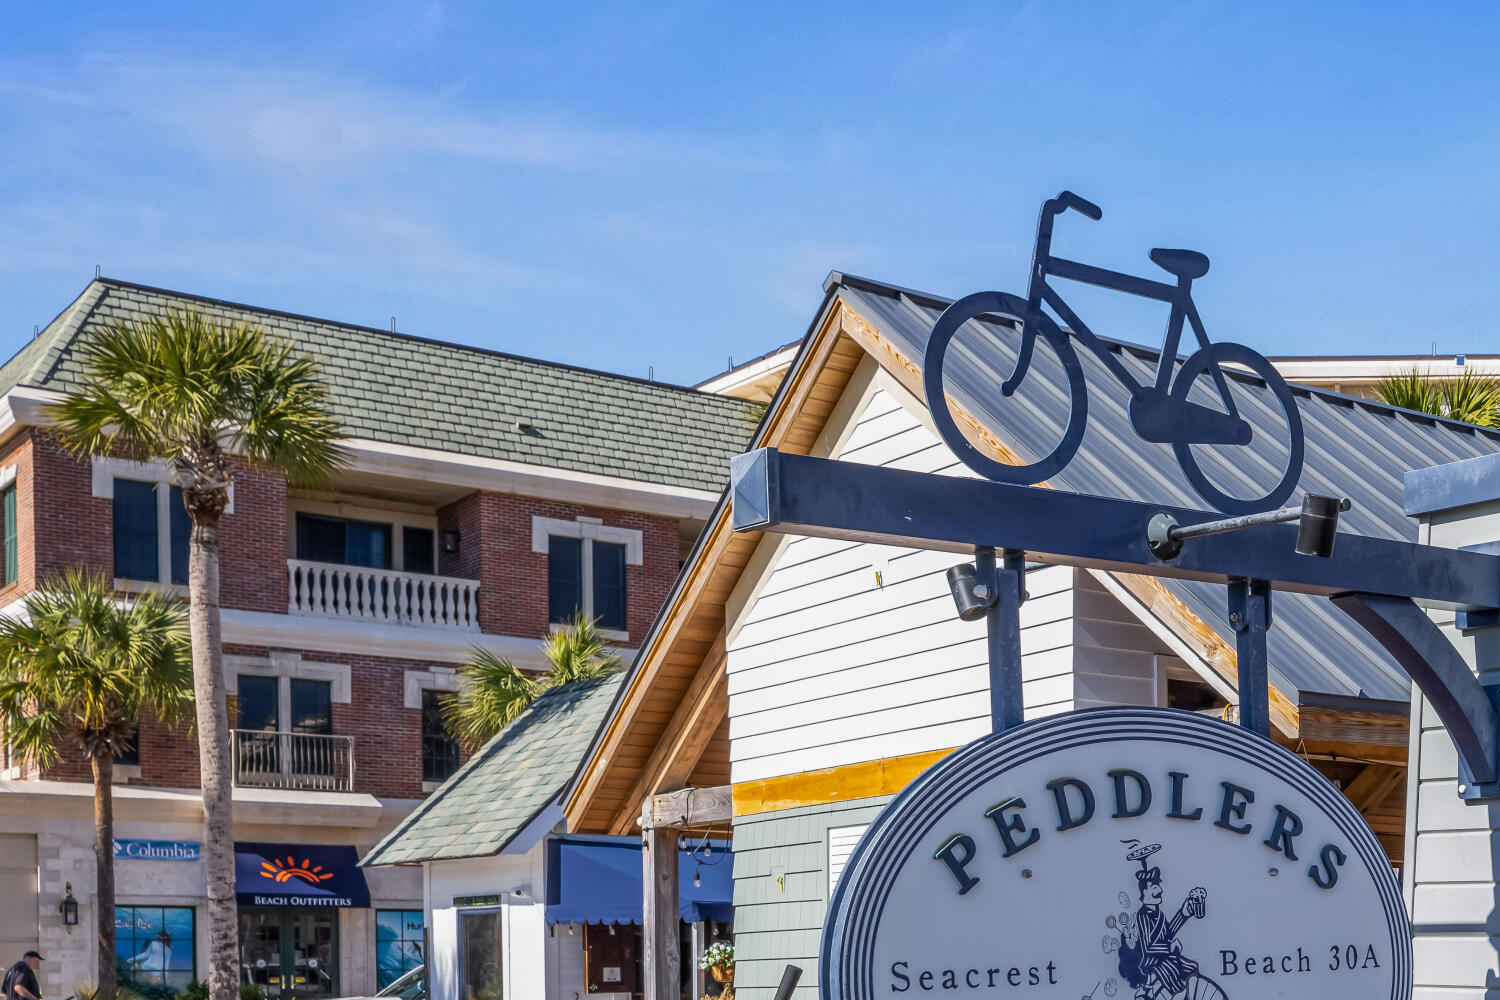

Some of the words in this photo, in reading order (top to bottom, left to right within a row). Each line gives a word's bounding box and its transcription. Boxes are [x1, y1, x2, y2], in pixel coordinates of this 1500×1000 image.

[933, 768, 1348, 896] PEDDLERS
[127, 842, 195, 858] Columbia
[254, 895, 288, 906] BEACH
[290, 896, 352, 907] OUTFITTERS
[891, 960, 1060, 993] Seacrest
[1219, 946, 1312, 977] Beach
[1329, 942, 1381, 972] 30A
